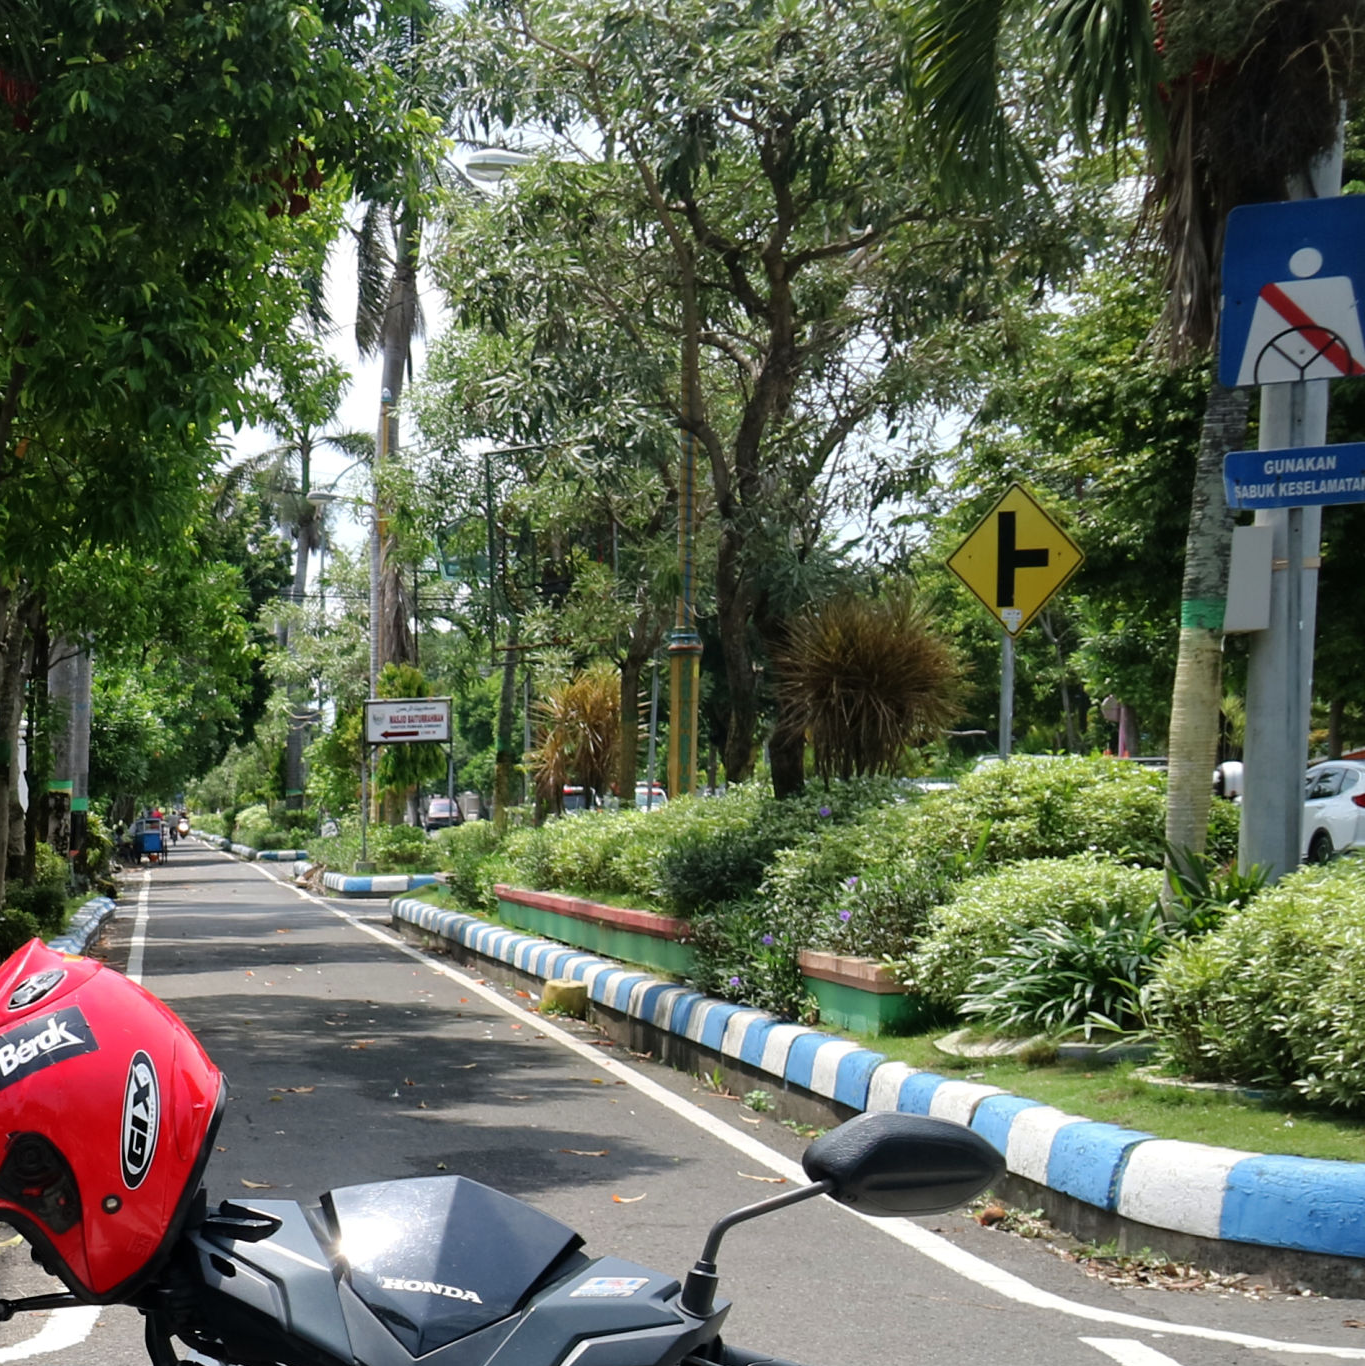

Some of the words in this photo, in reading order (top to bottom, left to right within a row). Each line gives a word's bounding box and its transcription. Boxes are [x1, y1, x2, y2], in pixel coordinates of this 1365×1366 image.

[1263, 455, 1337, 475] GUNAKAN
[1234, 483, 1275, 499] SABUK
[127, 1064, 151, 1169] GIX
[377, 1276, 484, 1305] HONDA
